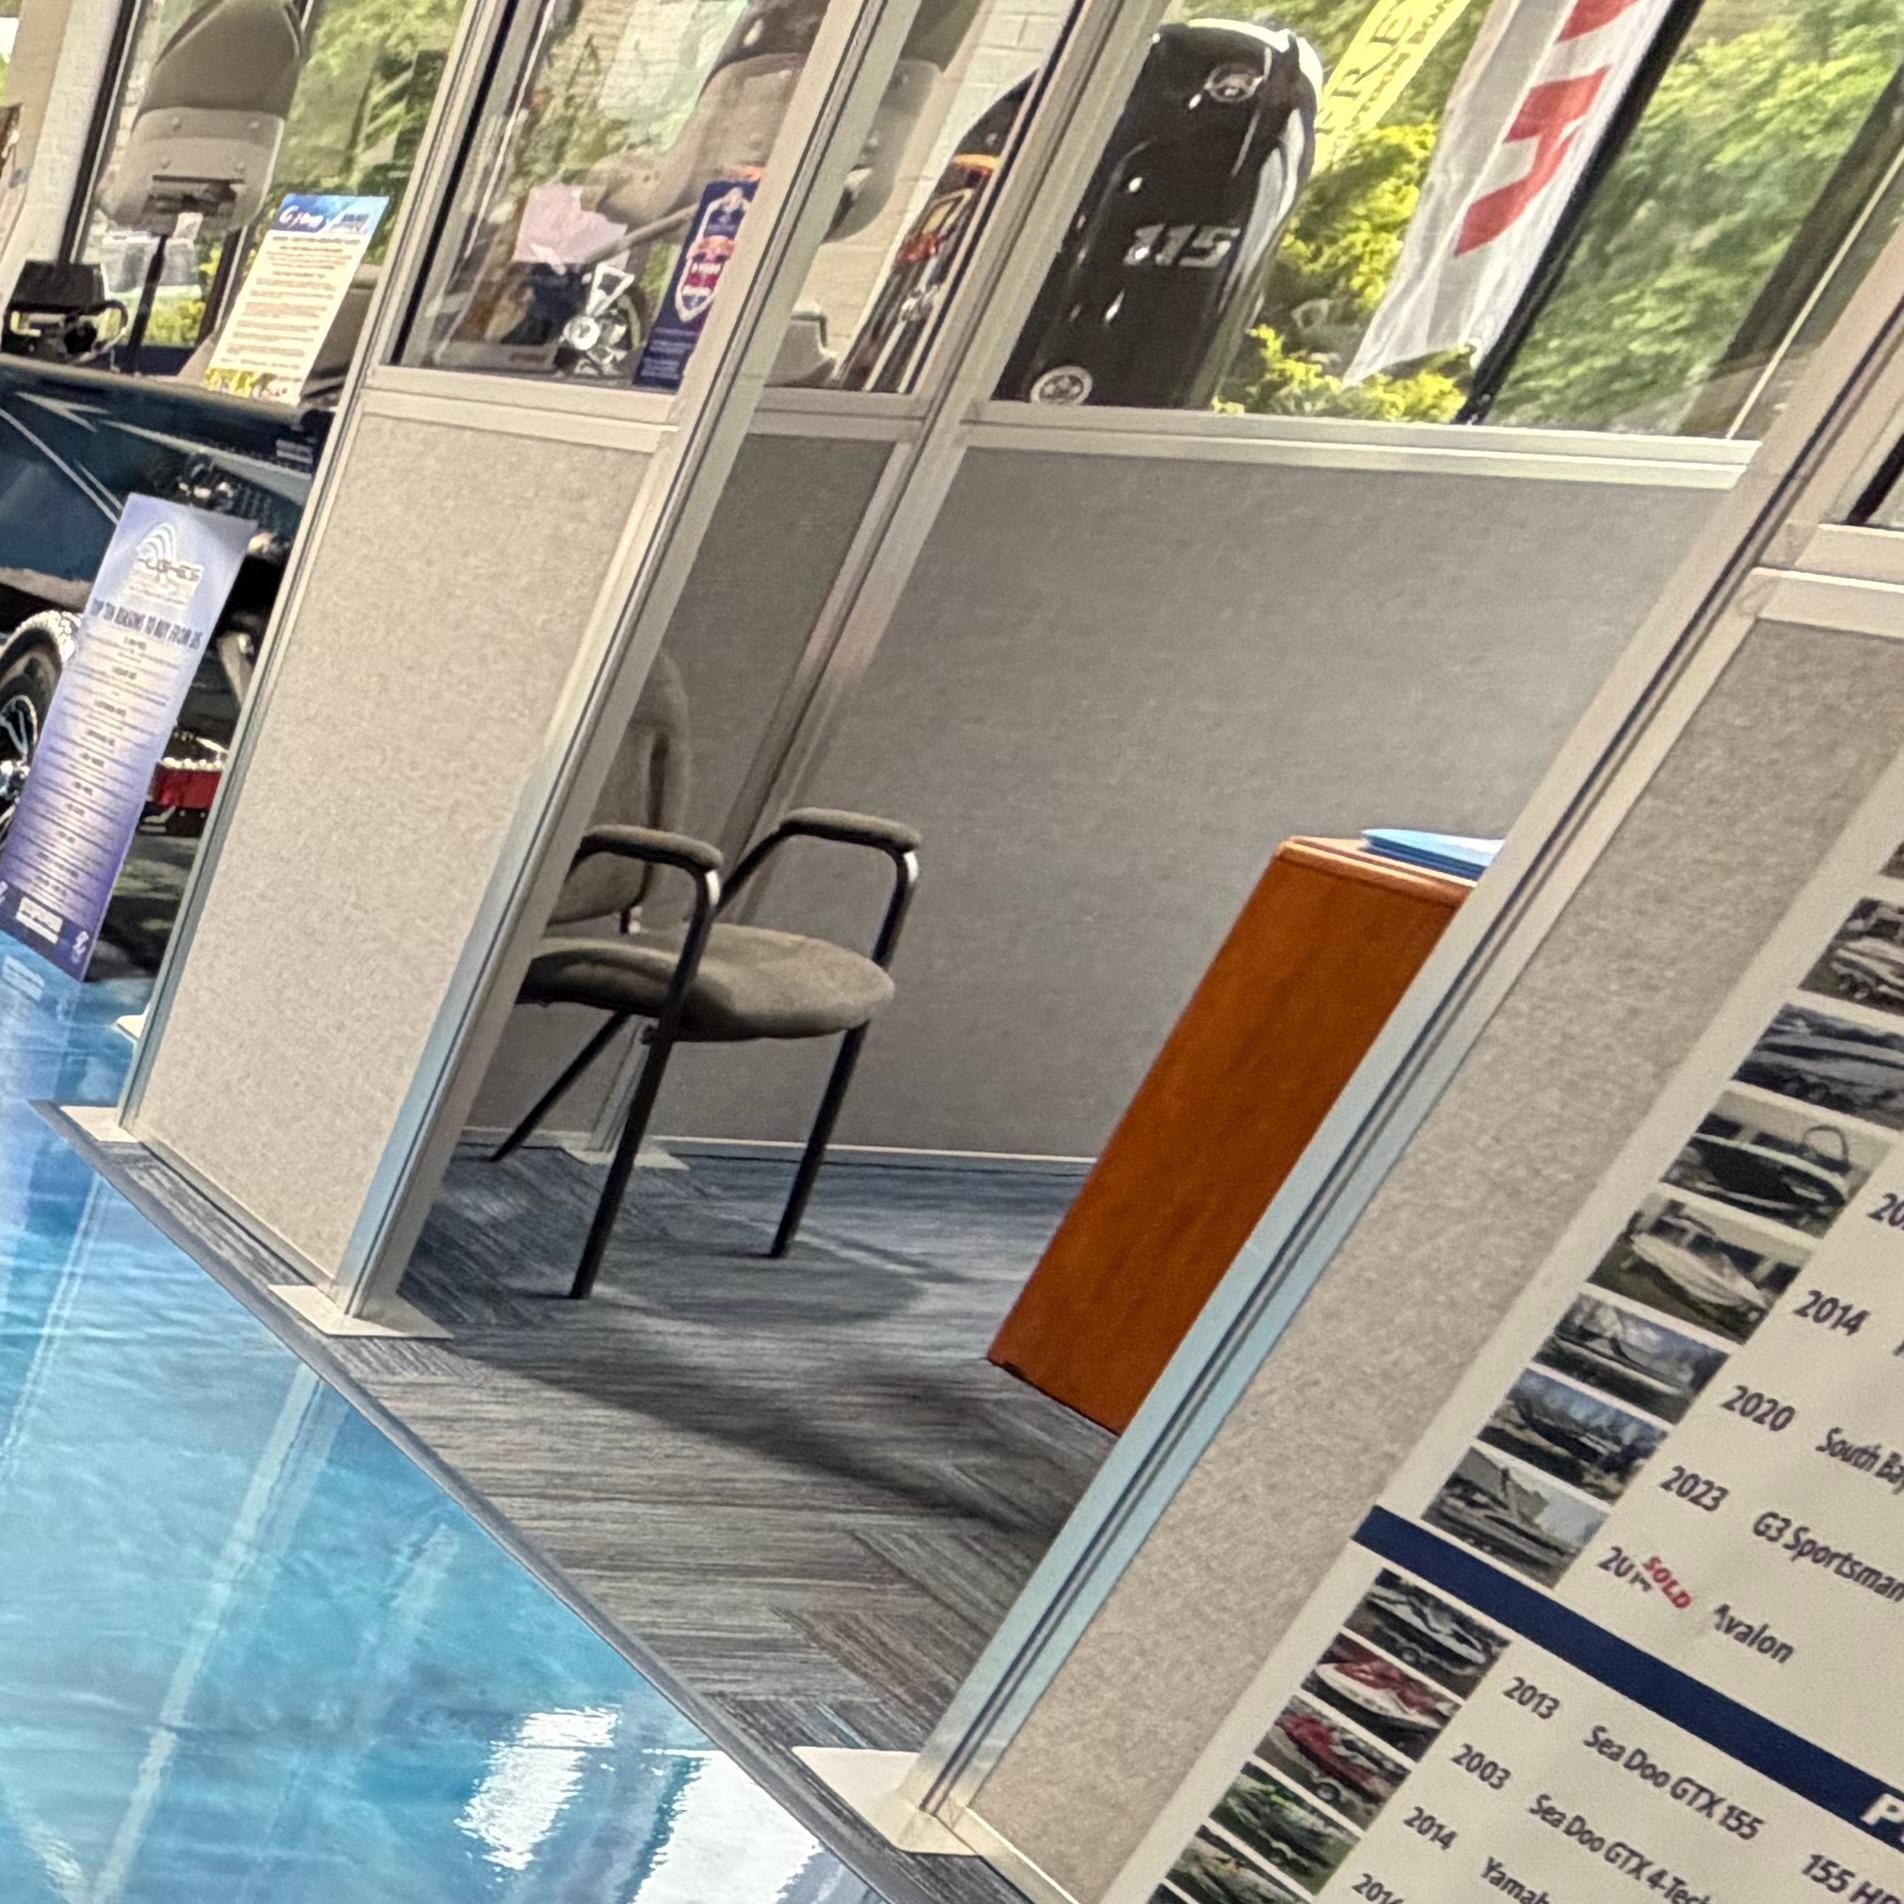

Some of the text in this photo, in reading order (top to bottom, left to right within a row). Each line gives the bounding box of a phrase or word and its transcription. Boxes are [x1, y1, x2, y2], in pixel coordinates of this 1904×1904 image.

[1124, 224, 1241, 266] 115
[1794, 1290, 1871, 1336] 2014
[1719, 1384, 1796, 1432] 2020
[1816, 1426, 1882, 1474] South
[1659, 1465, 1730, 1512] 2023
[1752, 1511, 1904, 1604] G3 Sportsman
[1642, 1555, 1693, 1611] SOLD
[1713, 1603, 1794, 1665] Avalon
[1503, 1676, 1560, 1720] 2013
[1583, 1725, 1627, 1763] Sea
[1623, 1748, 1671, 1789] Doo
[1670, 1776, 1726, 1819] GTX
[1719, 1804, 1766, 1841] 155
[1801, 1853, 1856, 1894] 155
[1403, 1806, 1459, 1852] 2014
[1450, 1743, 1512, 1791] 2003
[1528, 1793, 1568, 1828] Sea
[1564, 1814, 1606, 1853] Doo
[1604, 1841, 1653, 1881] GTX
